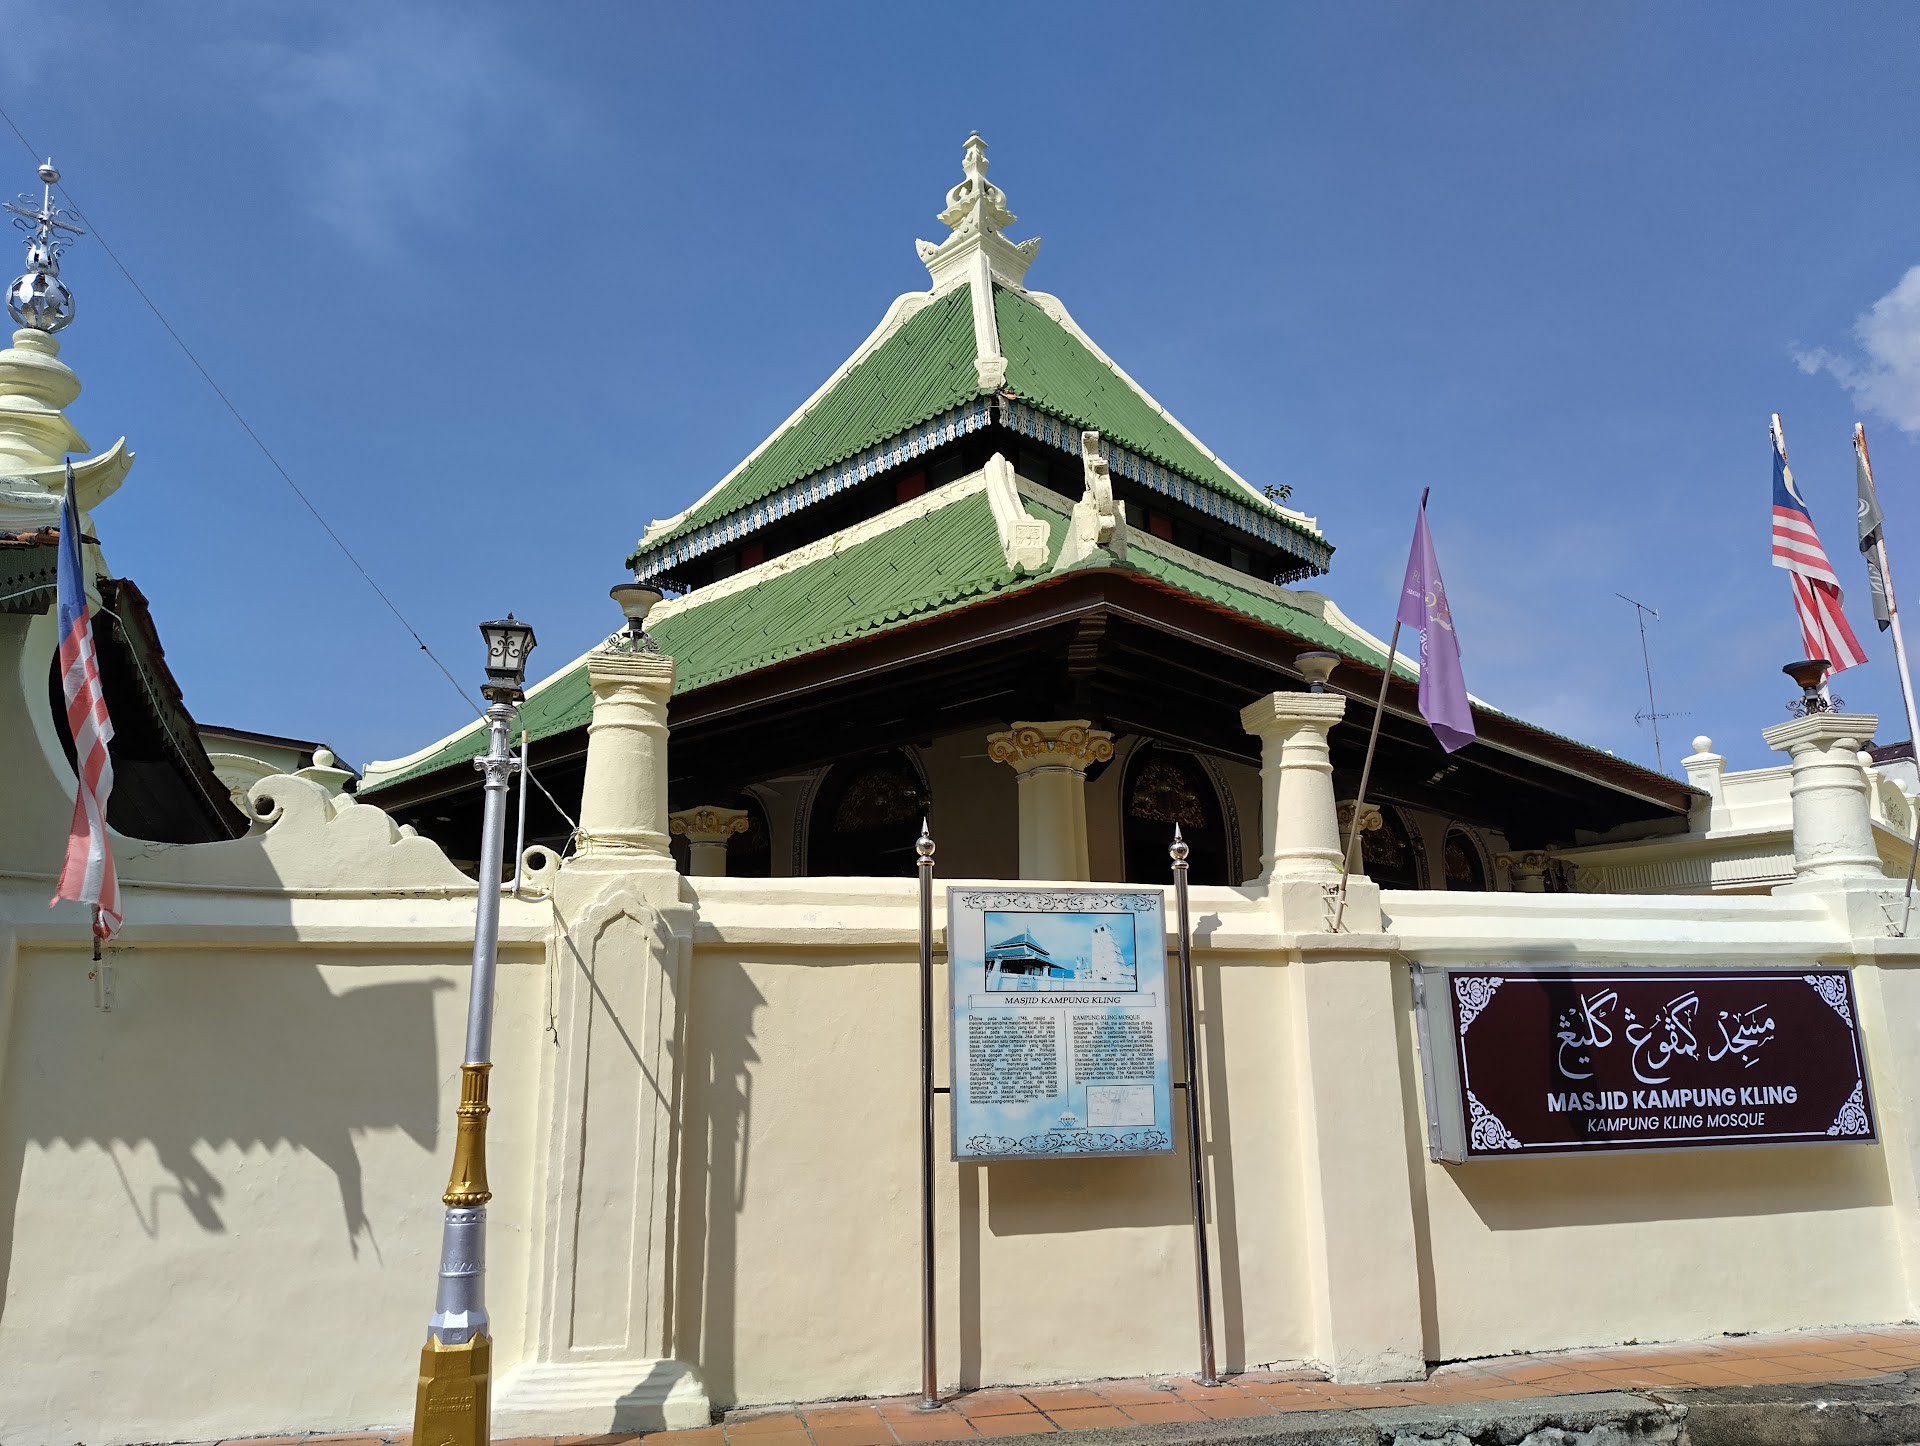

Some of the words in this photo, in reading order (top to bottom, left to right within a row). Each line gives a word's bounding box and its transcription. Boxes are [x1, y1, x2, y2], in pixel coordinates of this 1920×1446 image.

[1547, 1090, 1628, 1113] MASJID
[1633, 1088, 1736, 1110] KAMPUNG
[1739, 1086, 1797, 1105] KLING
[1587, 1117, 1659, 1132] KAMPUNG
[1663, 1115, 1703, 1129] KLING
[1707, 1112, 1765, 1128] MOSQUE
